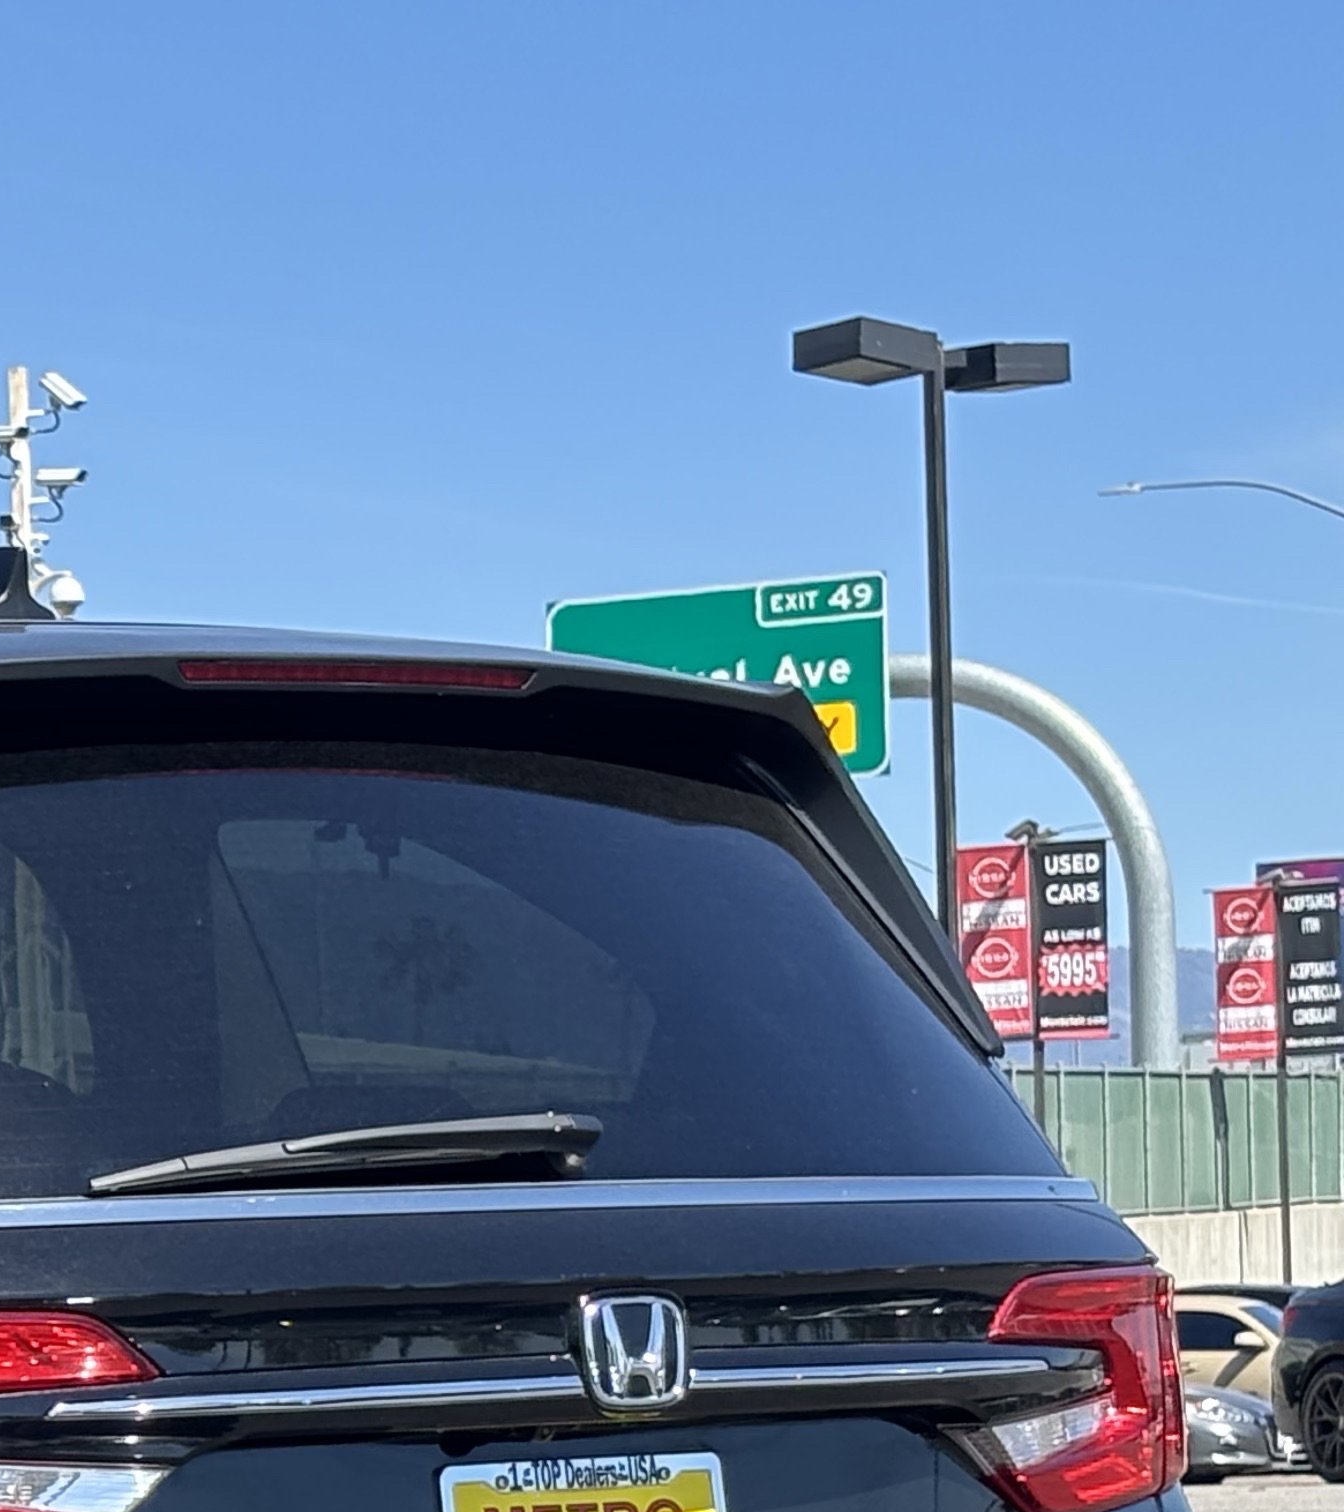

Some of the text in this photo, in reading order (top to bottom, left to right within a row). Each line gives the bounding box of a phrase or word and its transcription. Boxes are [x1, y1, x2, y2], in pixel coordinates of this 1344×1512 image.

[770, 583, 872, 614] EXIT 49
[774, 654, 851, 687] Ave
[1044, 853, 1100, 876] USED
[1045, 882, 1100, 904] CARS
[531, 1459, 561, 1491] TOP
[628, 1454, 660, 1486] USA
